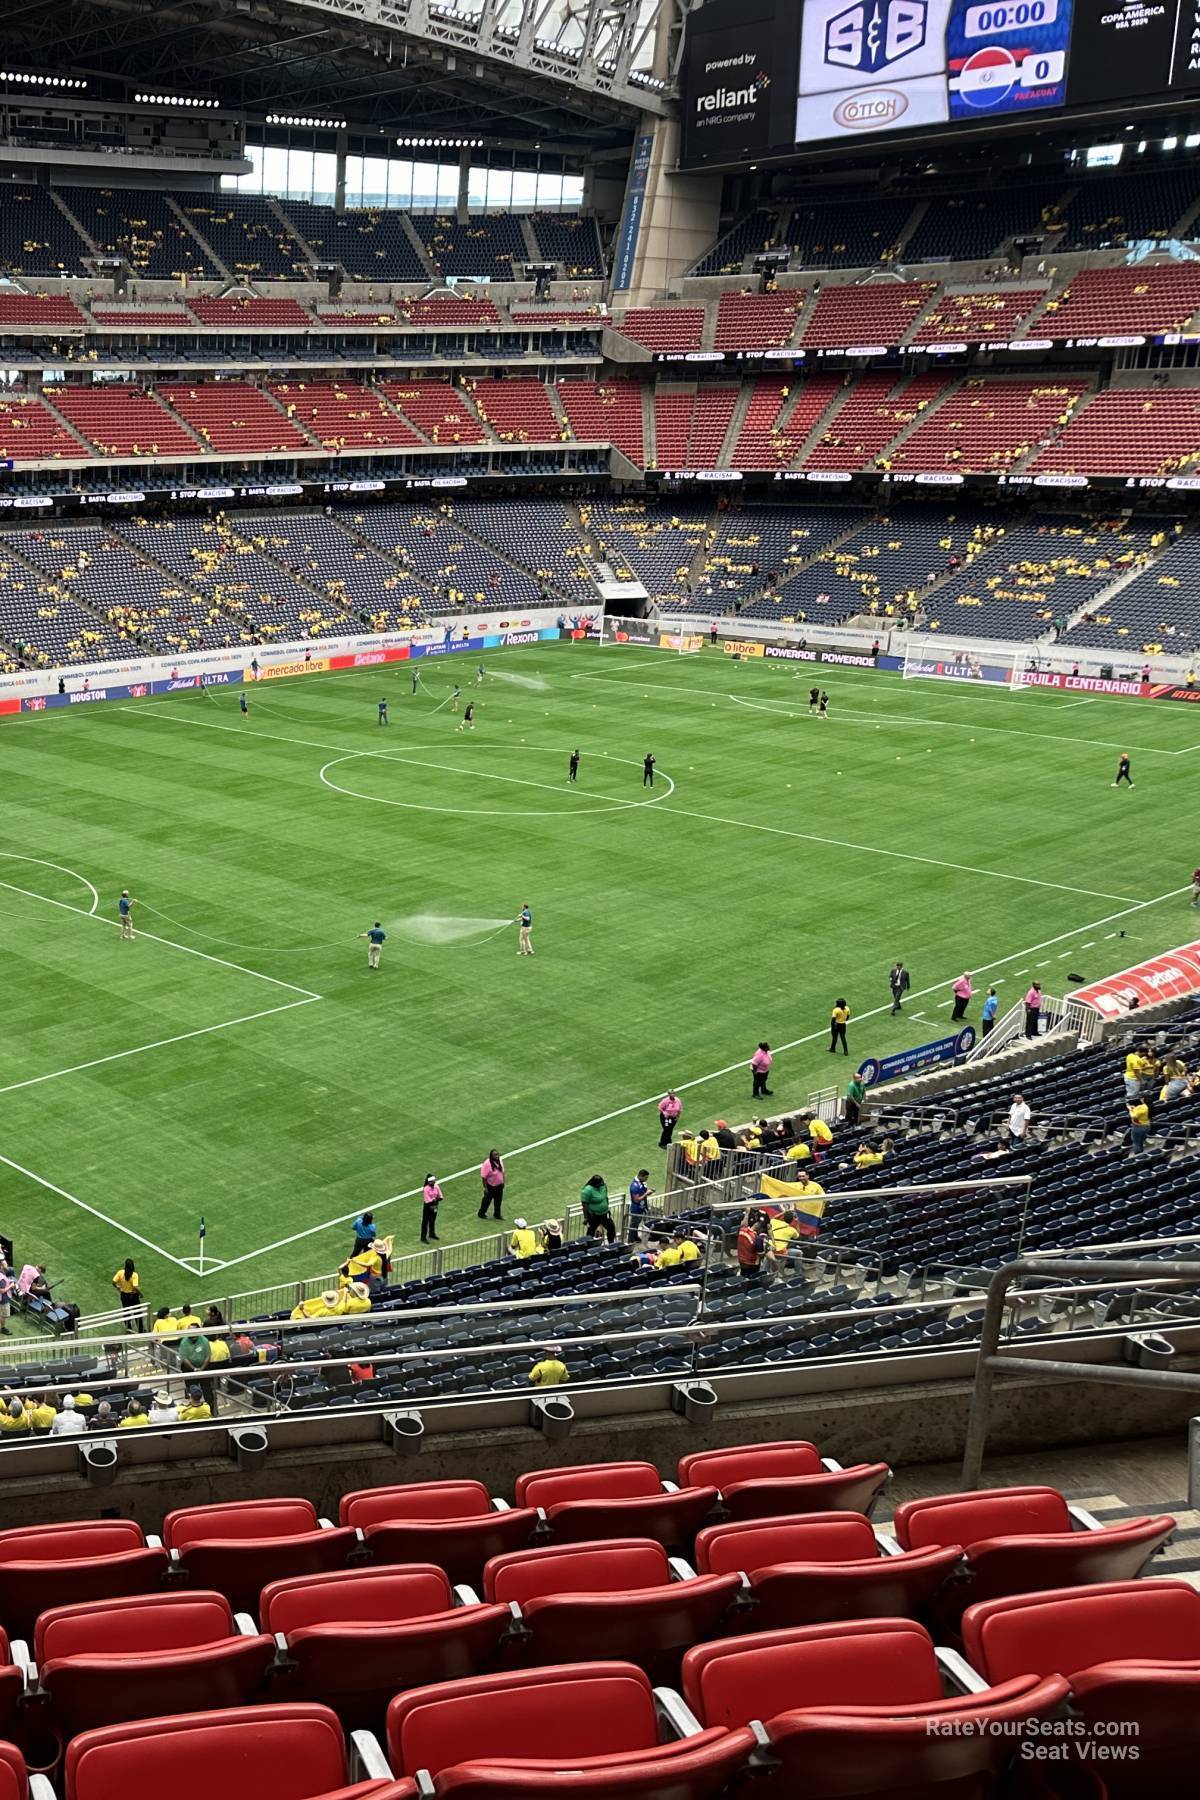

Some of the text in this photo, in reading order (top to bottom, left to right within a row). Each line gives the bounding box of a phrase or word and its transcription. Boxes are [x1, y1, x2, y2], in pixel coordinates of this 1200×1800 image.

[978, 2, 1045, 31] 00:00
[1101, 13, 1124, 24] COPA
[1125, 6, 1165, 20] AMERICA
[1116, 18, 1148, 29] USA 2024
[705, 53, 757, 72] powered by
[1035, 60, 1049, 79] 0
[697, 84, 757, 112] reliant
[706, 115, 722, 126] NRG
[723, 112, 756, 124] company
[1076, 339, 1097, 347] STOP
[893, 474, 913, 482] STOP
[1139, 478, 1165, 486] STOP
[506, 632, 538, 645] Rexona
[733, 644, 755, 654] libre
[765, 647, 816, 661] POWERADE
[354, 653, 385, 666] Betano
[822, 652, 875, 667] POWERADE
[267, 661, 323, 676] mercado libre
[1013, 672, 1141, 694] TEQUILA CENTENARIO
[70, 689, 106, 703] HOUSTON
